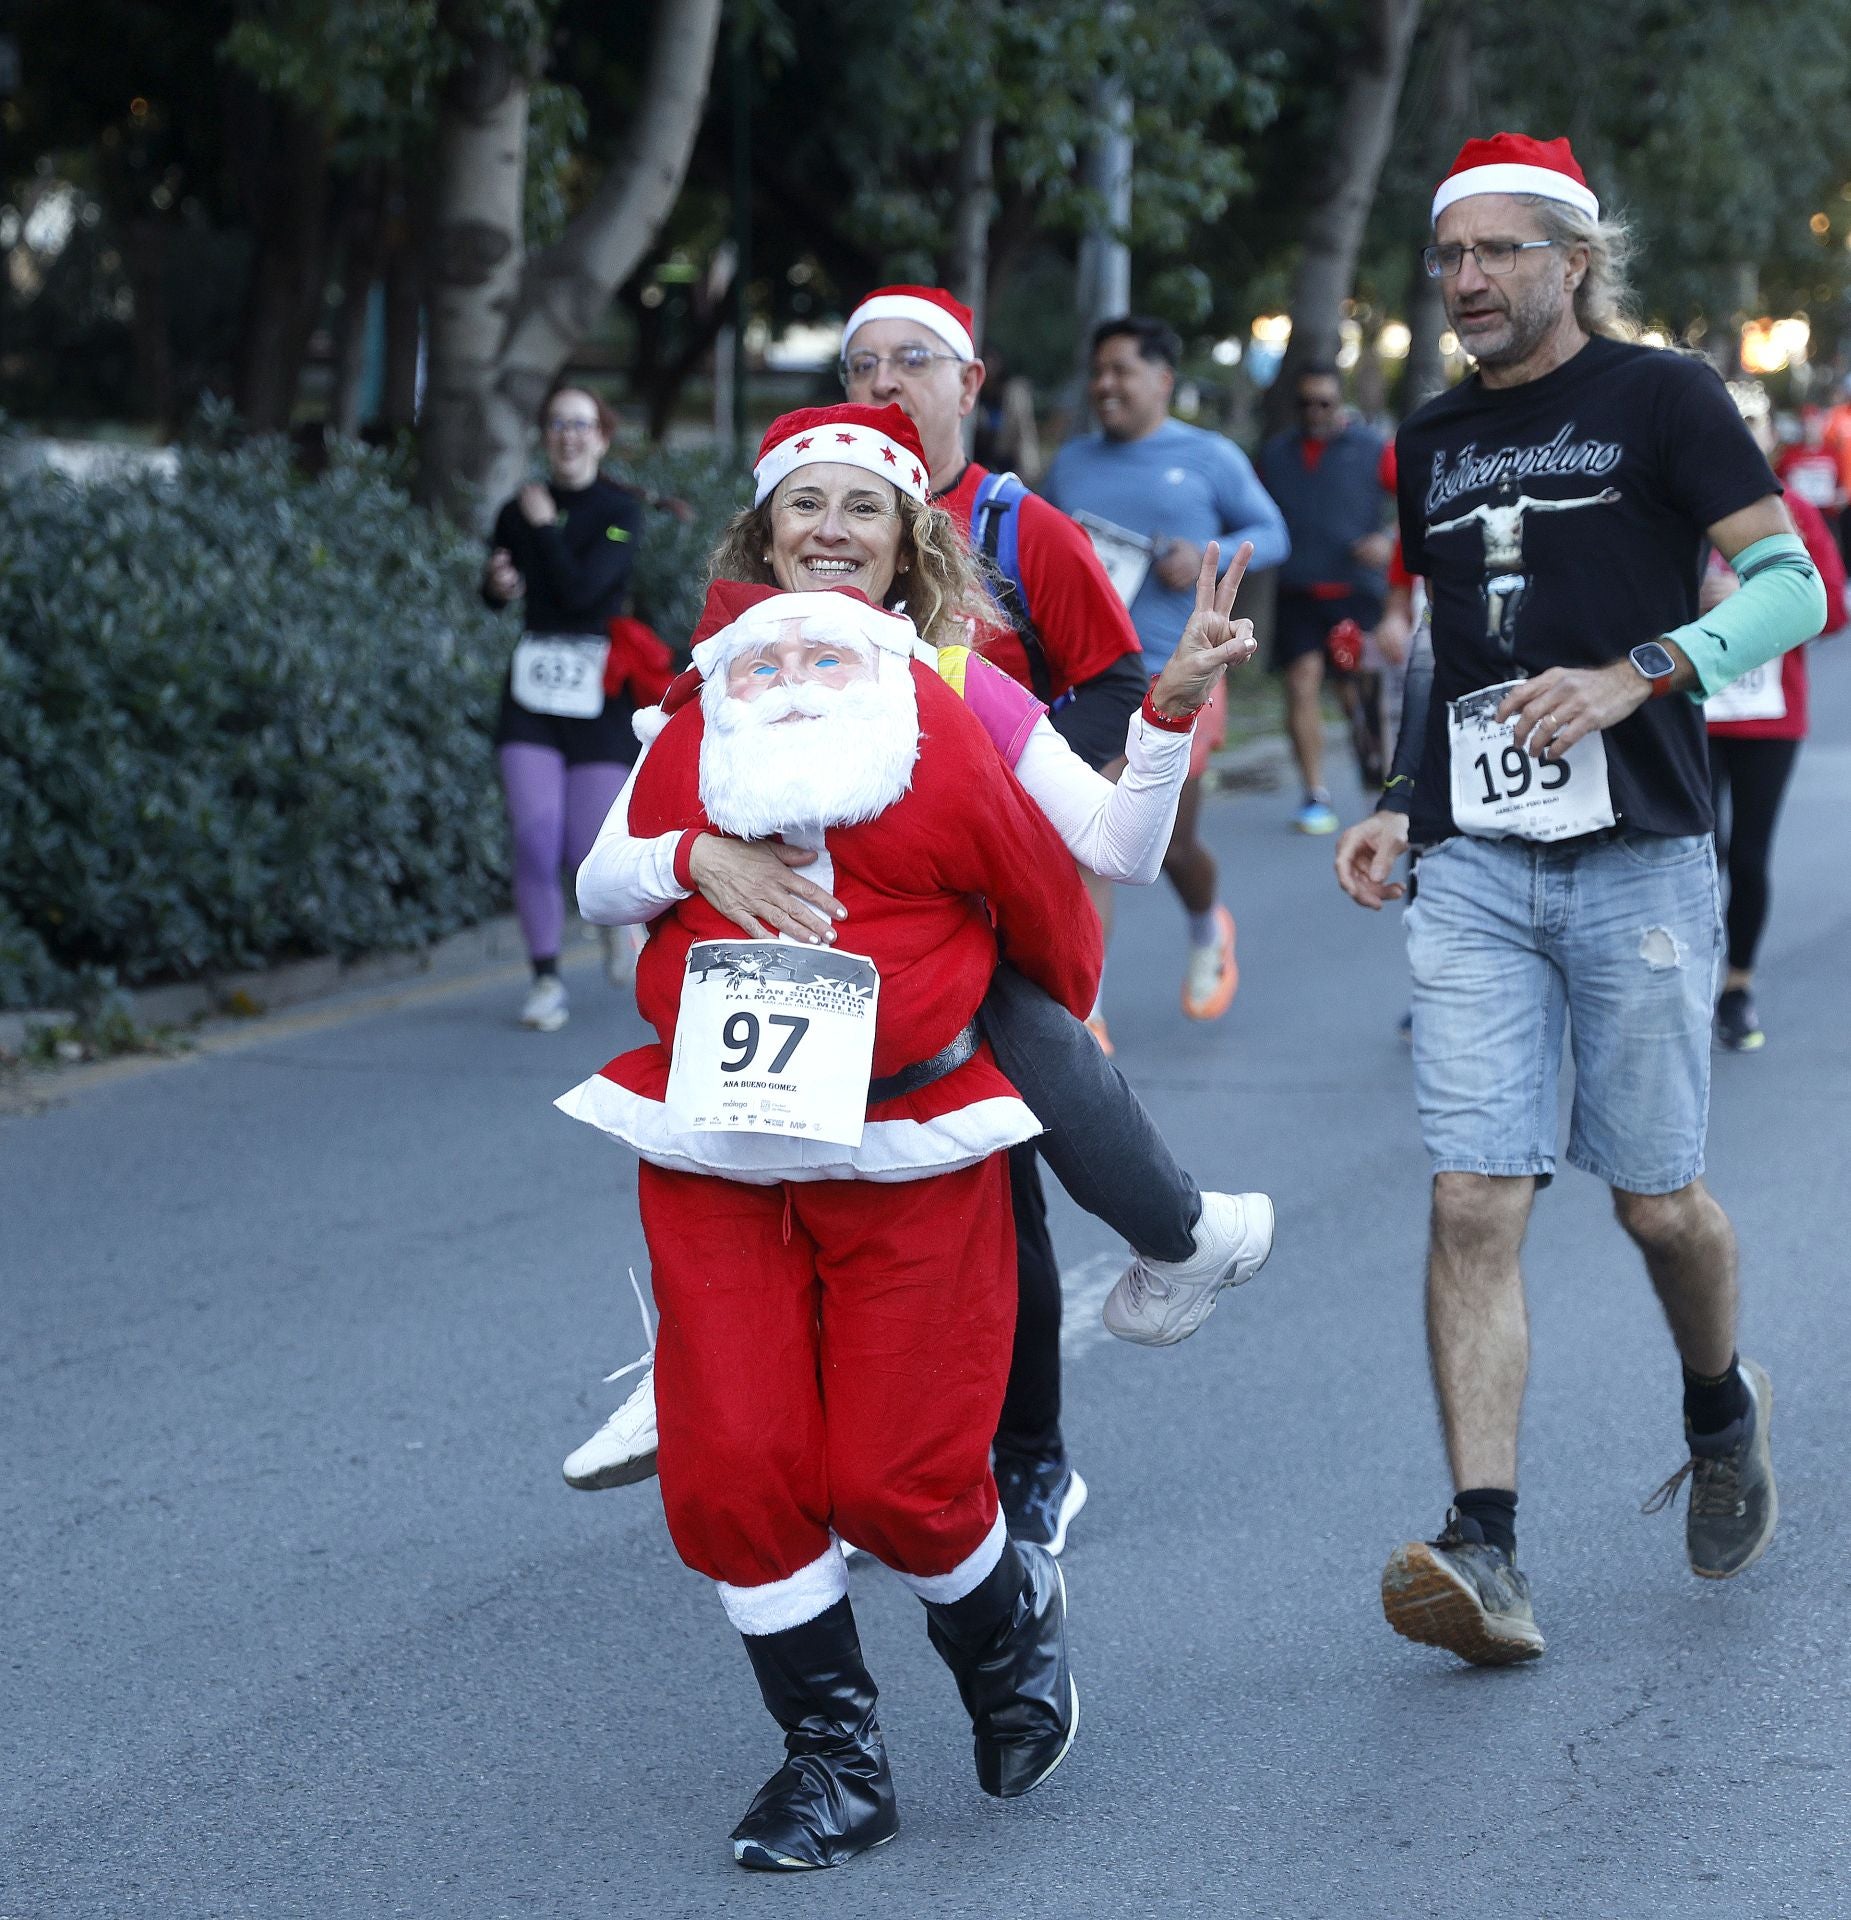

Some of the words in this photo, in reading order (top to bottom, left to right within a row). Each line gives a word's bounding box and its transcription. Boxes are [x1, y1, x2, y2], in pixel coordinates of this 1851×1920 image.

[1474, 739, 1572, 805] 195
[756, 988, 784, 996] SAN
[789, 990, 865, 1010] SILVESTRE
[795, 985, 865, 1004] CARRERA
[784, 997, 865, 1016] PALMILLA
[720, 1011, 810, 1074] 97
[722, 1080, 739, 1088] ANA
[740, 1080, 767, 1089] BUENO
[768, 1082, 797, 1092] GOMEZ
